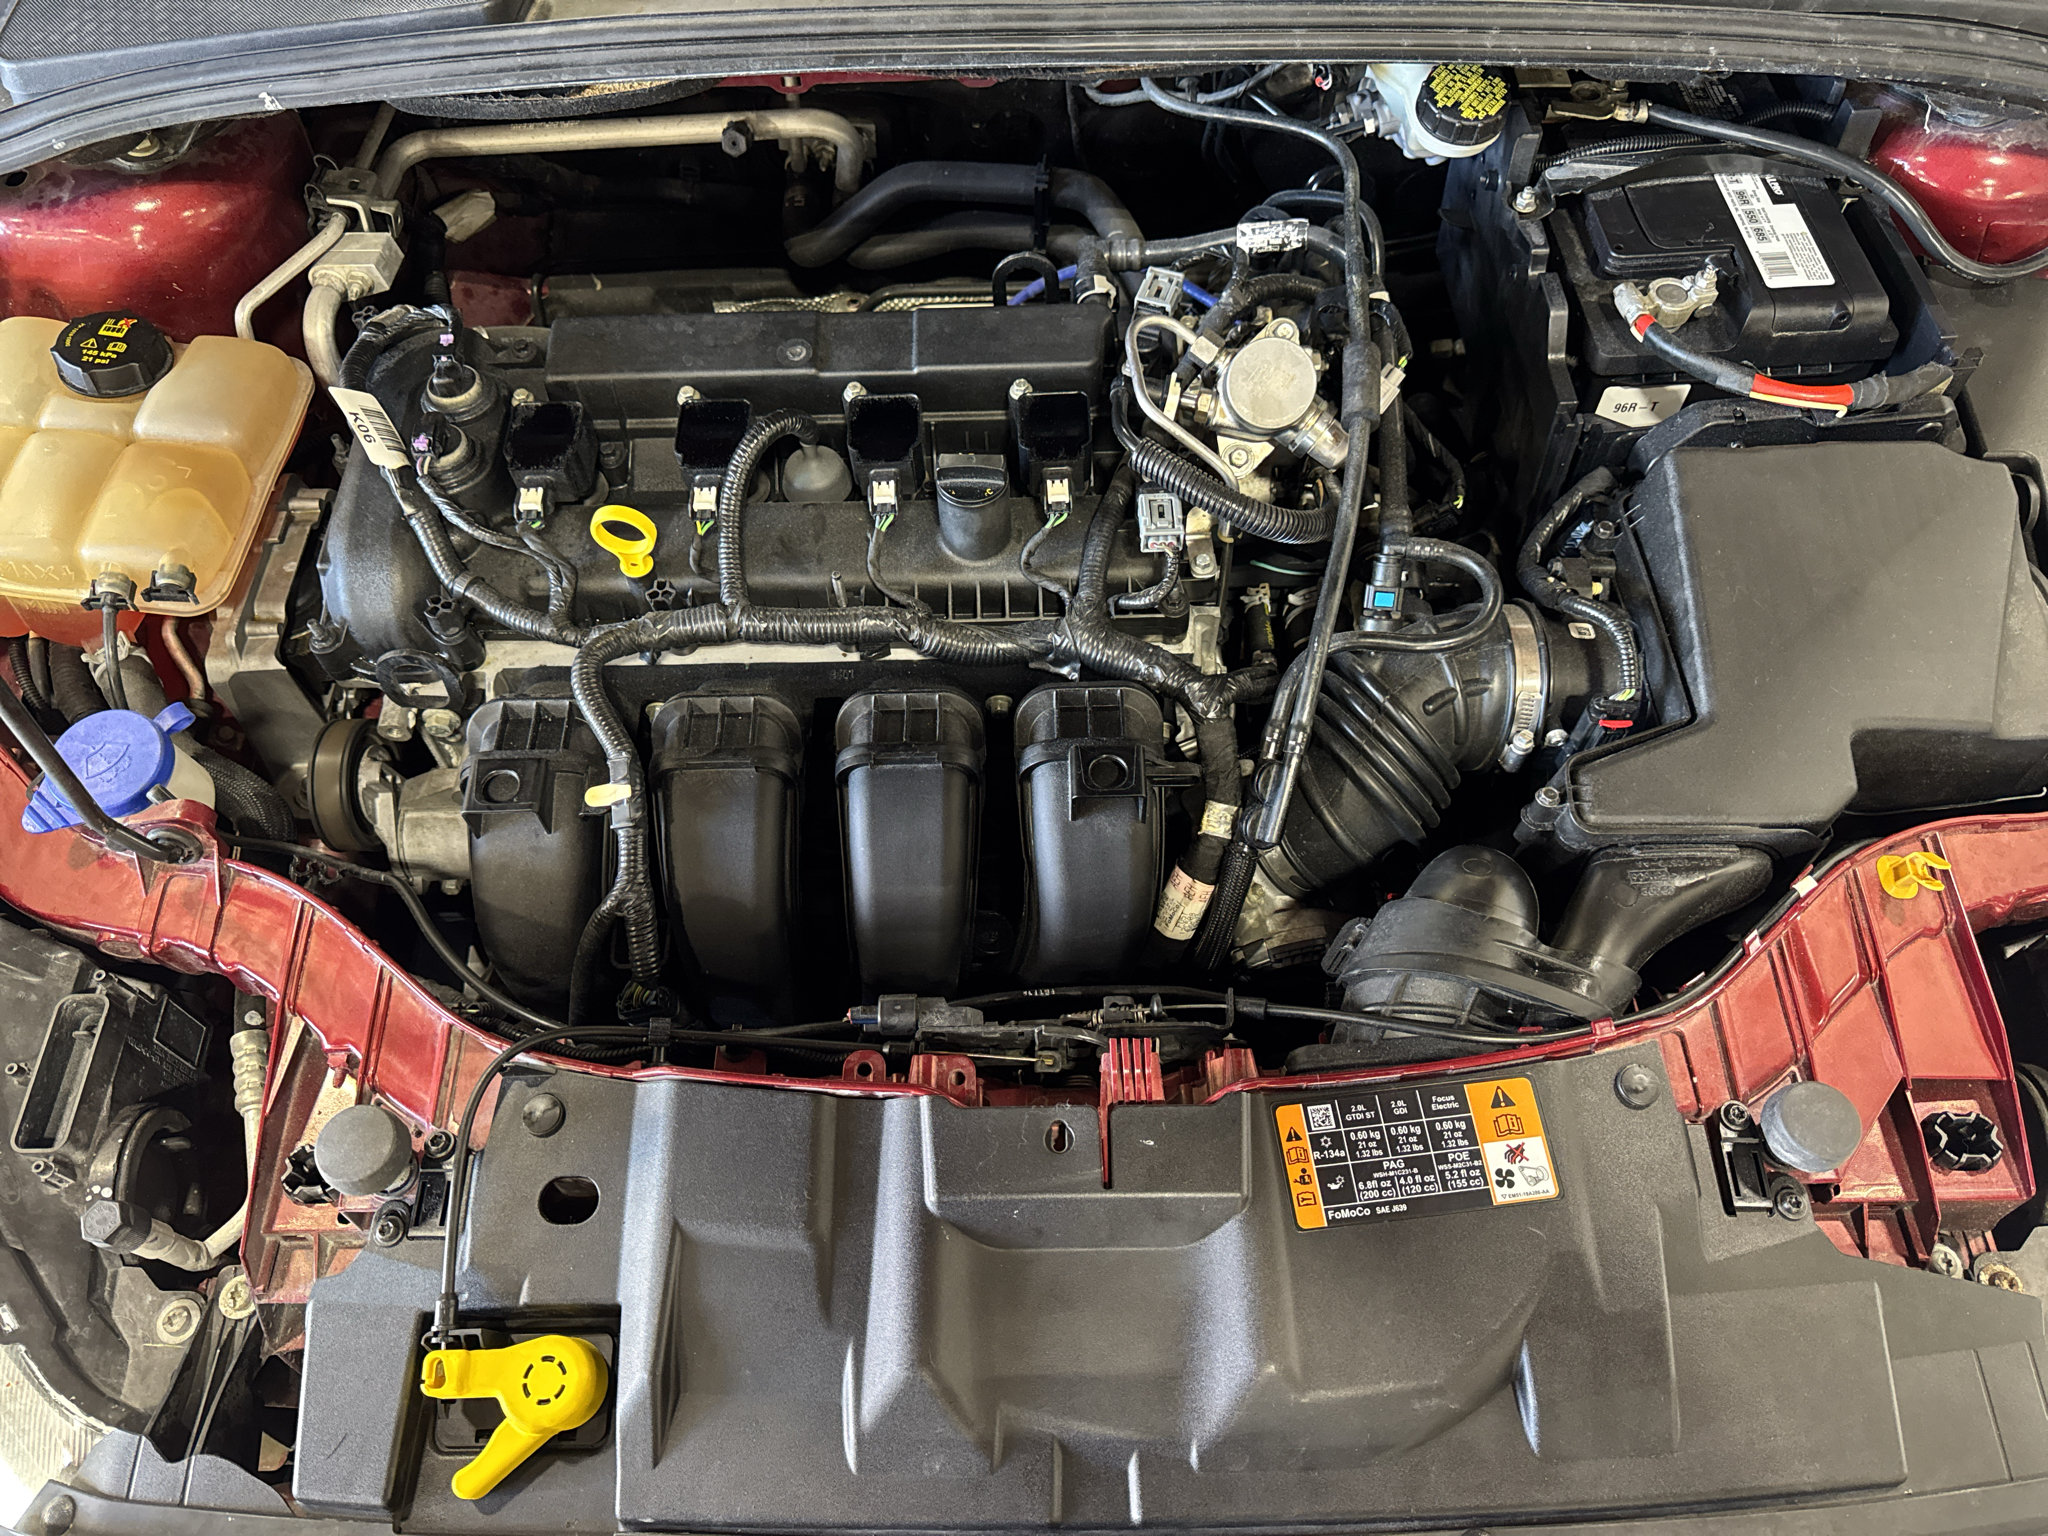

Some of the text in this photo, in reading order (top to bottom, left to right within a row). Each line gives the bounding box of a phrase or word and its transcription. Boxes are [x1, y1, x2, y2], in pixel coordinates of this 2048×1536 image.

[1735, 190, 1750, 205] 96R
[1744, 210, 1759, 224] 550
[1753, 227, 1768, 241] 685
[100, 351, 117, 359] kPa
[348, 411, 376, 443] K06
[1390, 1100, 1407, 1108] 2.0L
[1432, 1095, 1455, 1103] Focus
[1350, 1104, 1367, 1112] 2.0L
[1393, 1107, 1408, 1115] GDI
[1431, 1102, 1459, 1111] Electric
[1345, 1111, 1375, 1121] GTDI ST
[1390, 1124, 1421, 1135] 0.60 kg
[1435, 1120, 1466, 1131] 0.60 kg
[1350, 1129, 1380, 1140] 0.60 kg
[1398, 1136, 1406, 1144] 21
[1443, 1131, 1452, 1139] 21
[1358, 1141, 1366, 1149] 21
[1396, 1143, 1424, 1153] 1.32 lbs
[1441, 1138, 1469, 1148] 1.32 lbs
[1313, 1149, 1346, 1160] R-134a
[1355, 1149, 1383, 1158] 1.32 lbs
[1447, 1151, 1470, 1162] POE
[1383, 1159, 1405, 1170] PAG
[1445, 1169, 1481, 1180] 5.2 fl oz
[1400, 1176, 1413, 1185] 4.0
[1447, 1177, 1484, 1190] (155 cc)
[1360, 1187, 1396, 1201] (200 cc)
[1402, 1182, 1438, 1195] (120 cc)
[1328, 1204, 1407, 1220] FoMoCo SAE J639
